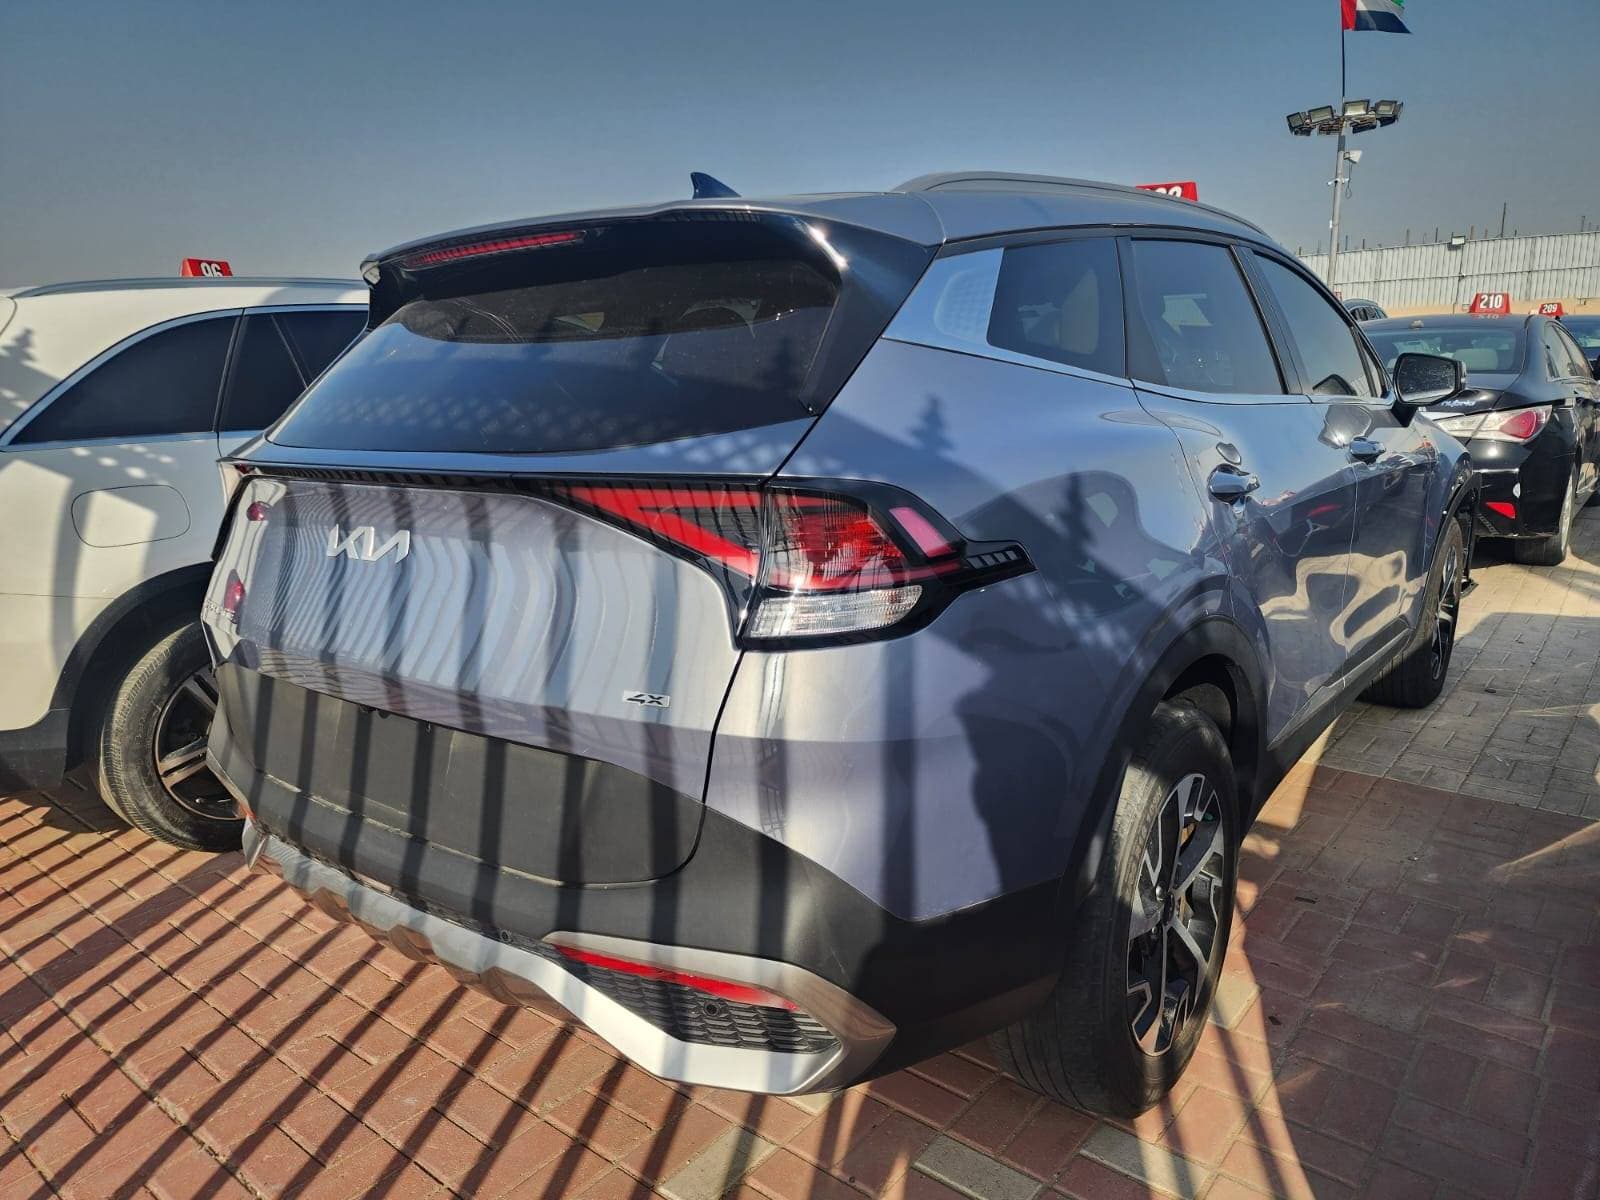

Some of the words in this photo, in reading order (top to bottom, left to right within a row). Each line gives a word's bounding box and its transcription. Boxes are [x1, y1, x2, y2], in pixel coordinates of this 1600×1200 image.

[1479, 294, 1502, 309] 210
[1542, 303, 1558, 314] 209
[326, 523, 410, 564] KIA
